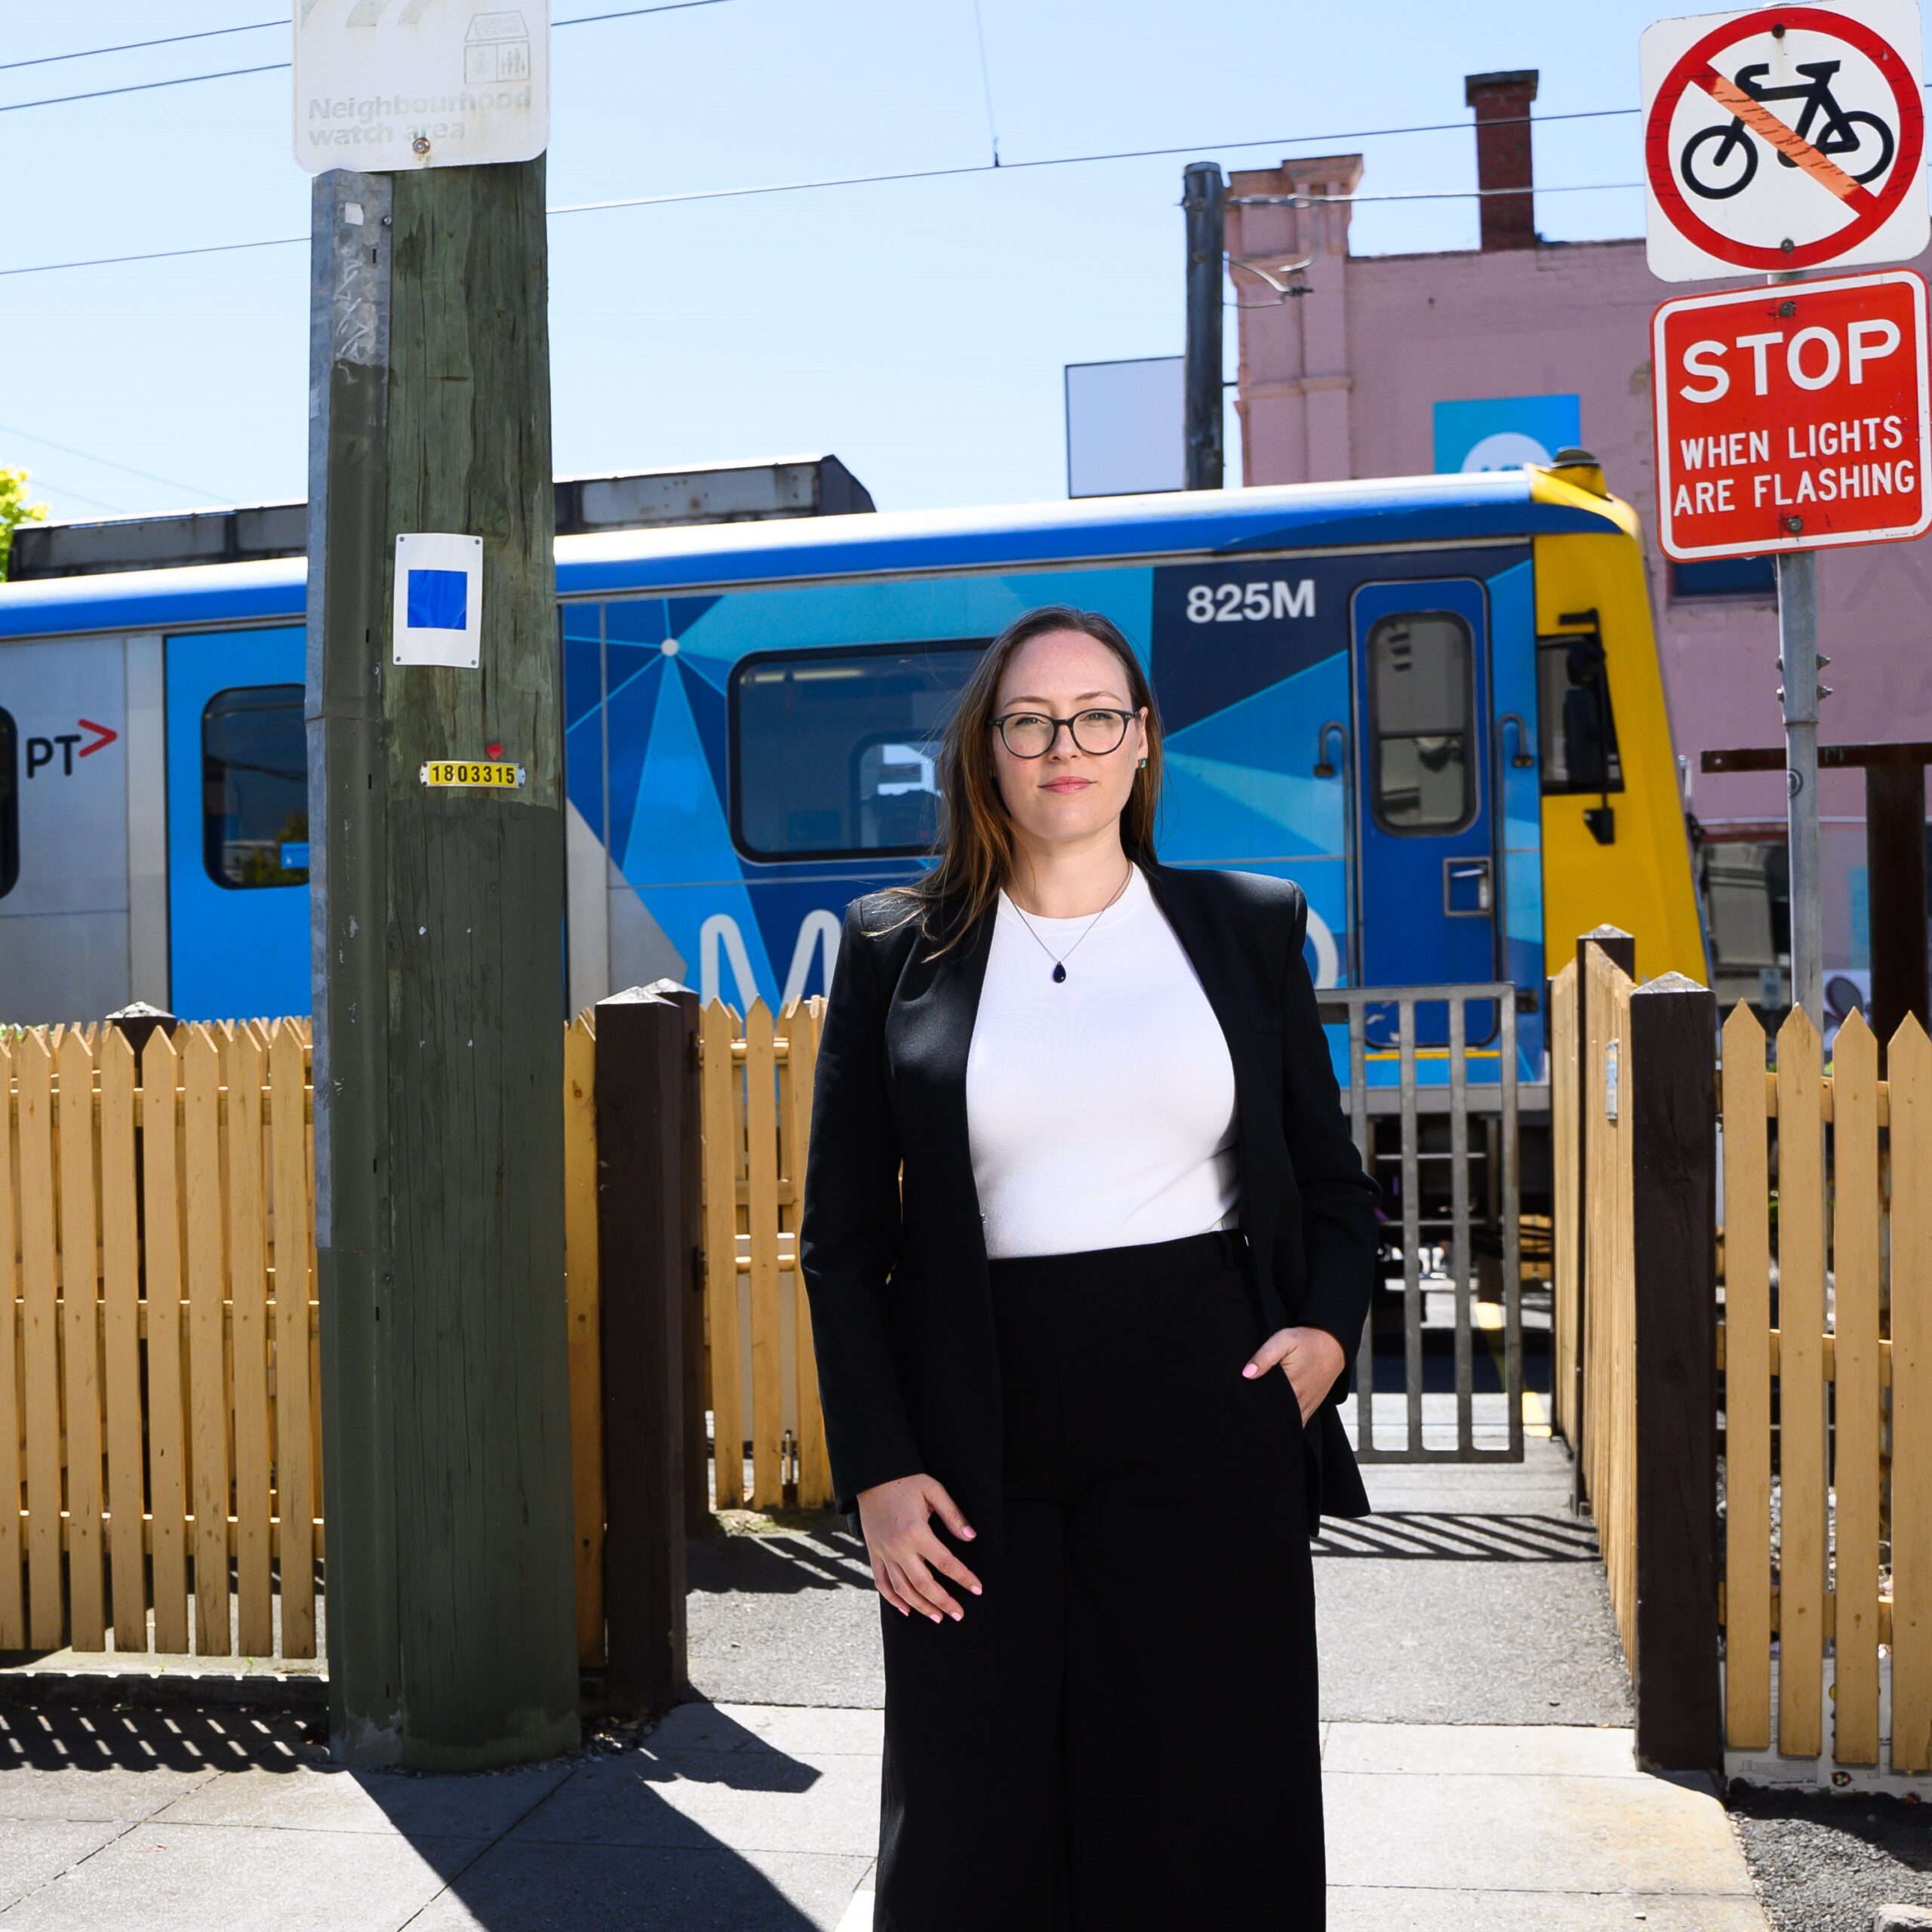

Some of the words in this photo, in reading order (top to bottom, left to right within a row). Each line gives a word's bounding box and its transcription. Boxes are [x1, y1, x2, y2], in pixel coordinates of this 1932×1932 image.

[309, 86, 531, 123] Neighbourhood
[308, 122, 393, 146] watch
[406, 122, 465, 141] area
[1679, 318, 1901, 403] STOP
[1680, 429, 1769, 470] WHEN
[1788, 415, 1903, 459] LIGHTS
[1673, 479, 1735, 517] ARE
[1754, 460, 1915, 508] FLASHING
[1186, 579, 1315, 623] 825M
[432, 764, 515, 784] 1803315
